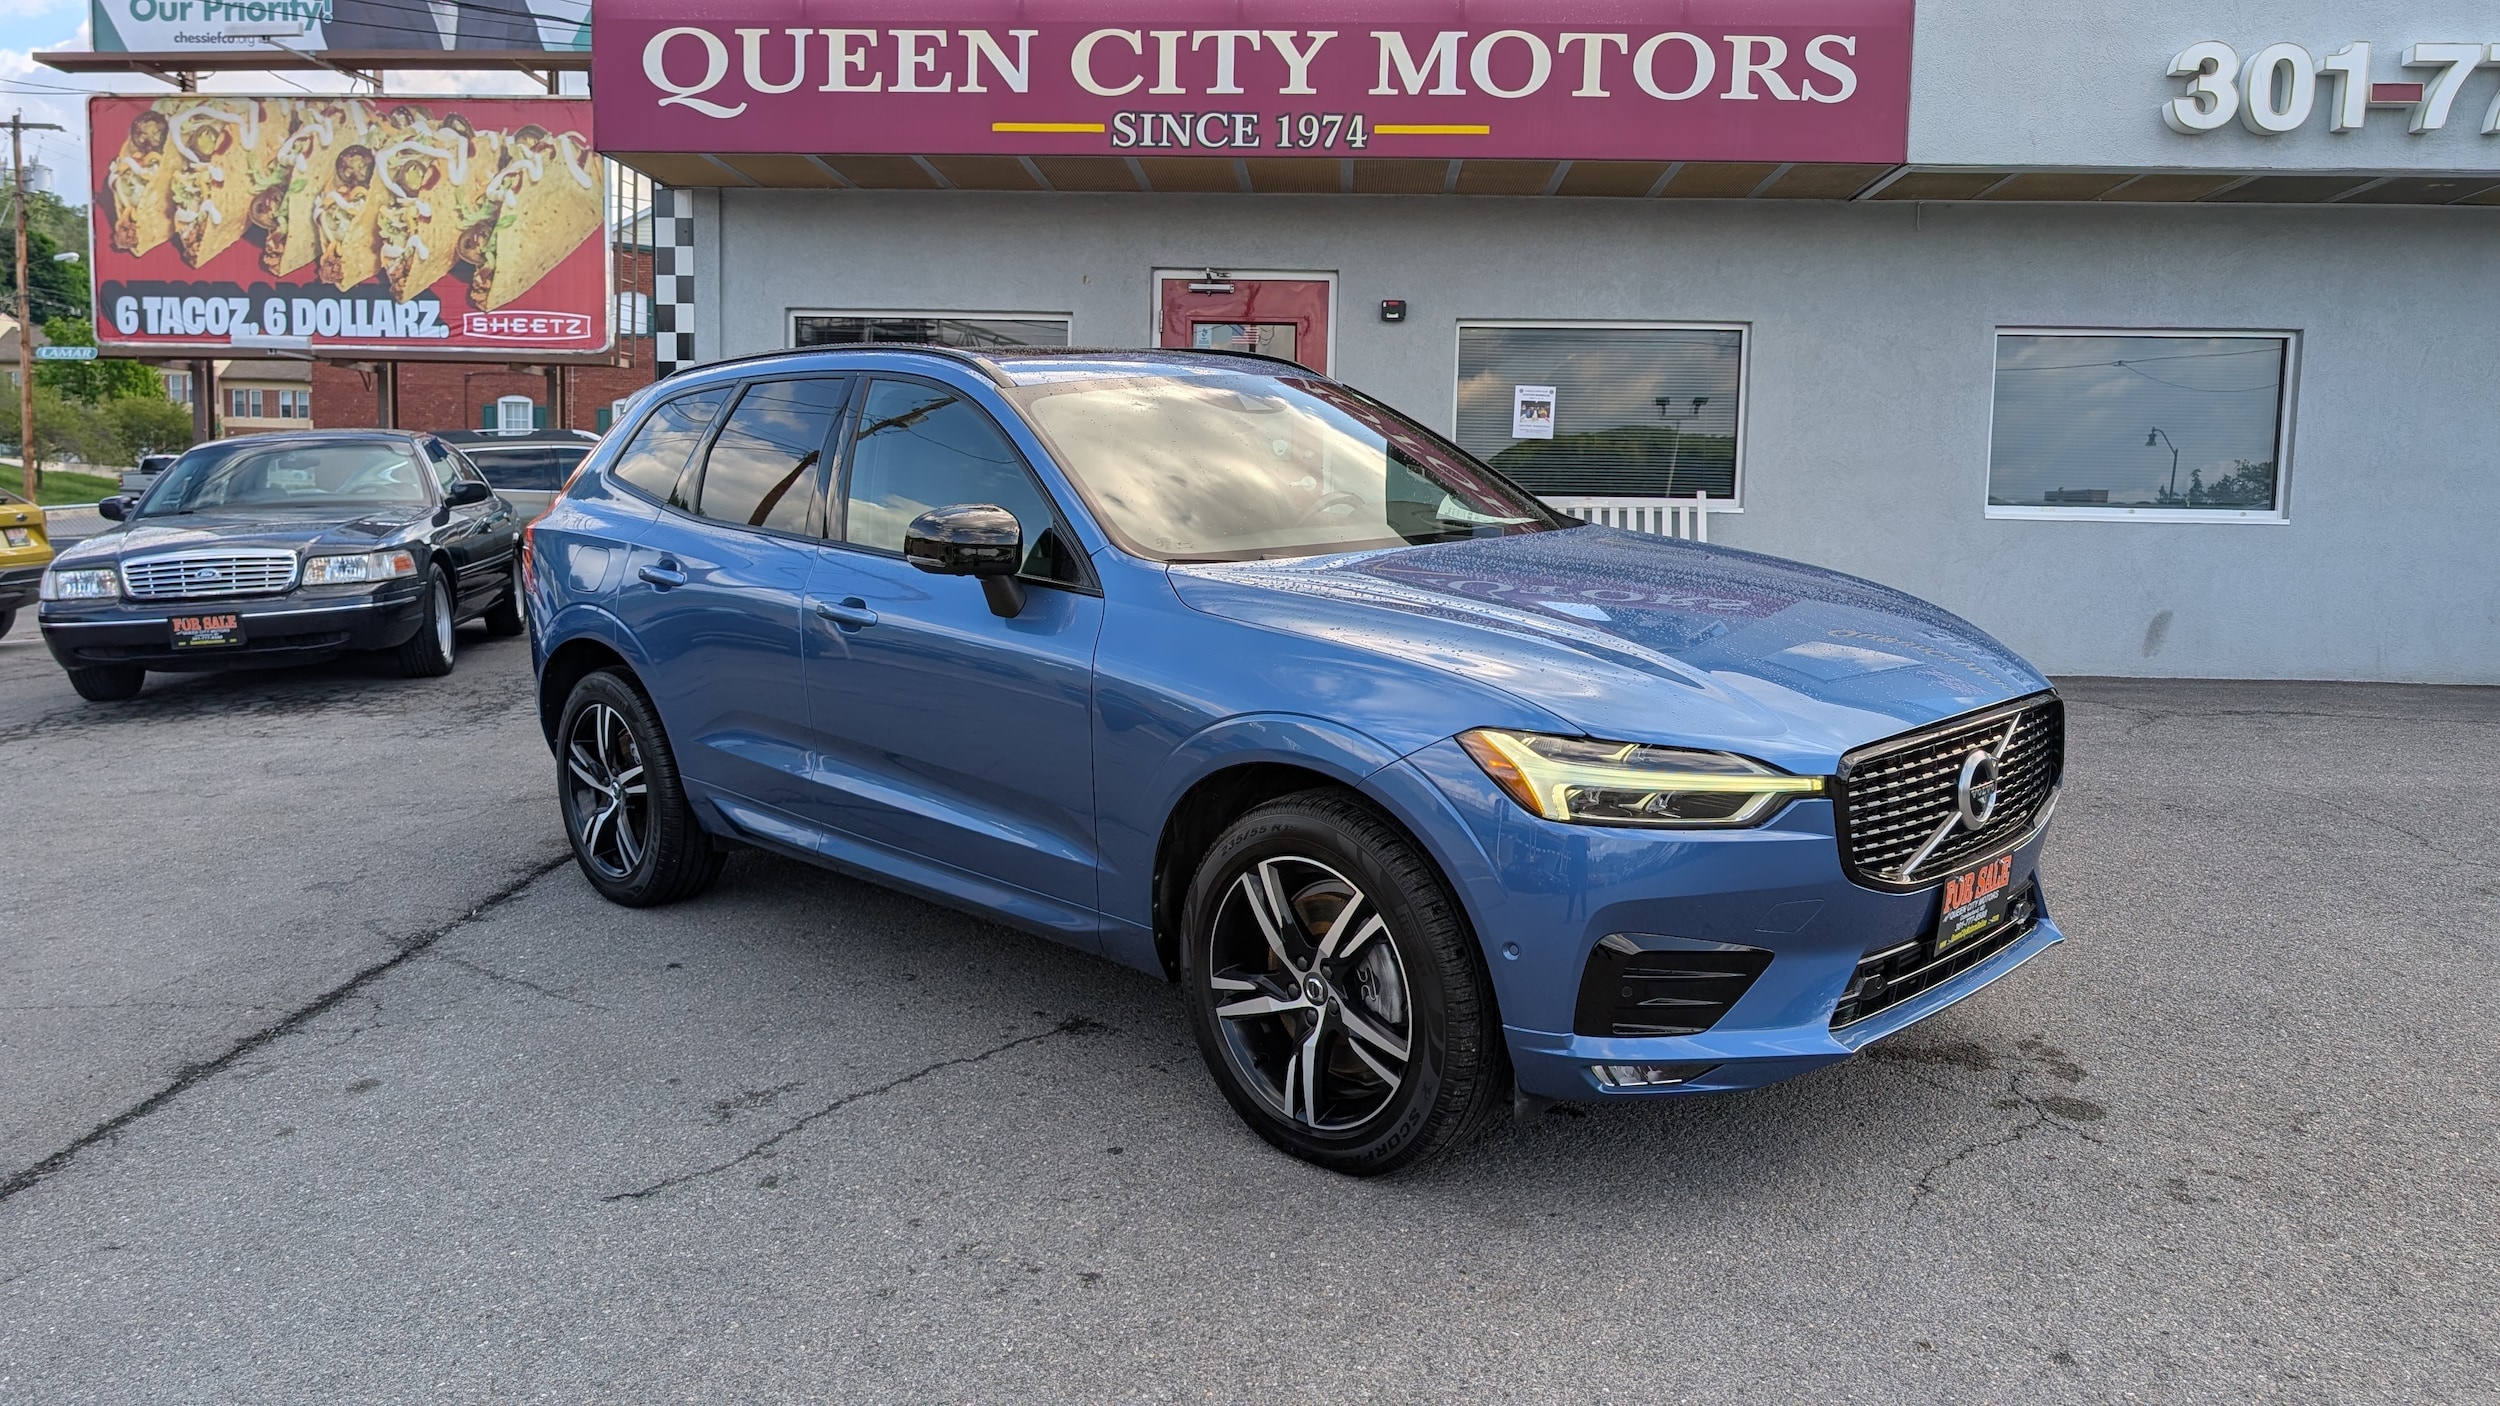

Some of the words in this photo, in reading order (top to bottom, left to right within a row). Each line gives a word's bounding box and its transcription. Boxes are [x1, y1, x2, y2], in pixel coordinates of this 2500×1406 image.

[129, 0, 194, 22] Our
[203, 0, 333, 31] Priority!
[642, 26, 1039, 119] QUEEN
[1070, 28, 1338, 97] CITY
[1368, 29, 1858, 104] MOTORS
[2161, 40, 2500, 136] 301-7
[1110, 112, 1261, 149] SINCE
[1274, 113, 1369, 150] 1974
[116, 296, 140, 336] 6
[143, 296, 259, 337] TACOZ.
[263, 297, 287, 337] 6
[292, 298, 450, 339] DOLLARZ.
[472, 317, 581, 334] SHEETZ
[42, 348, 92, 358] LAMAR
[172, 617, 202, 632] FOR
[202, 614, 238, 630] SALE
[1943, 872, 1975, 915] FOR
[1975, 854, 2012, 899] SALE
